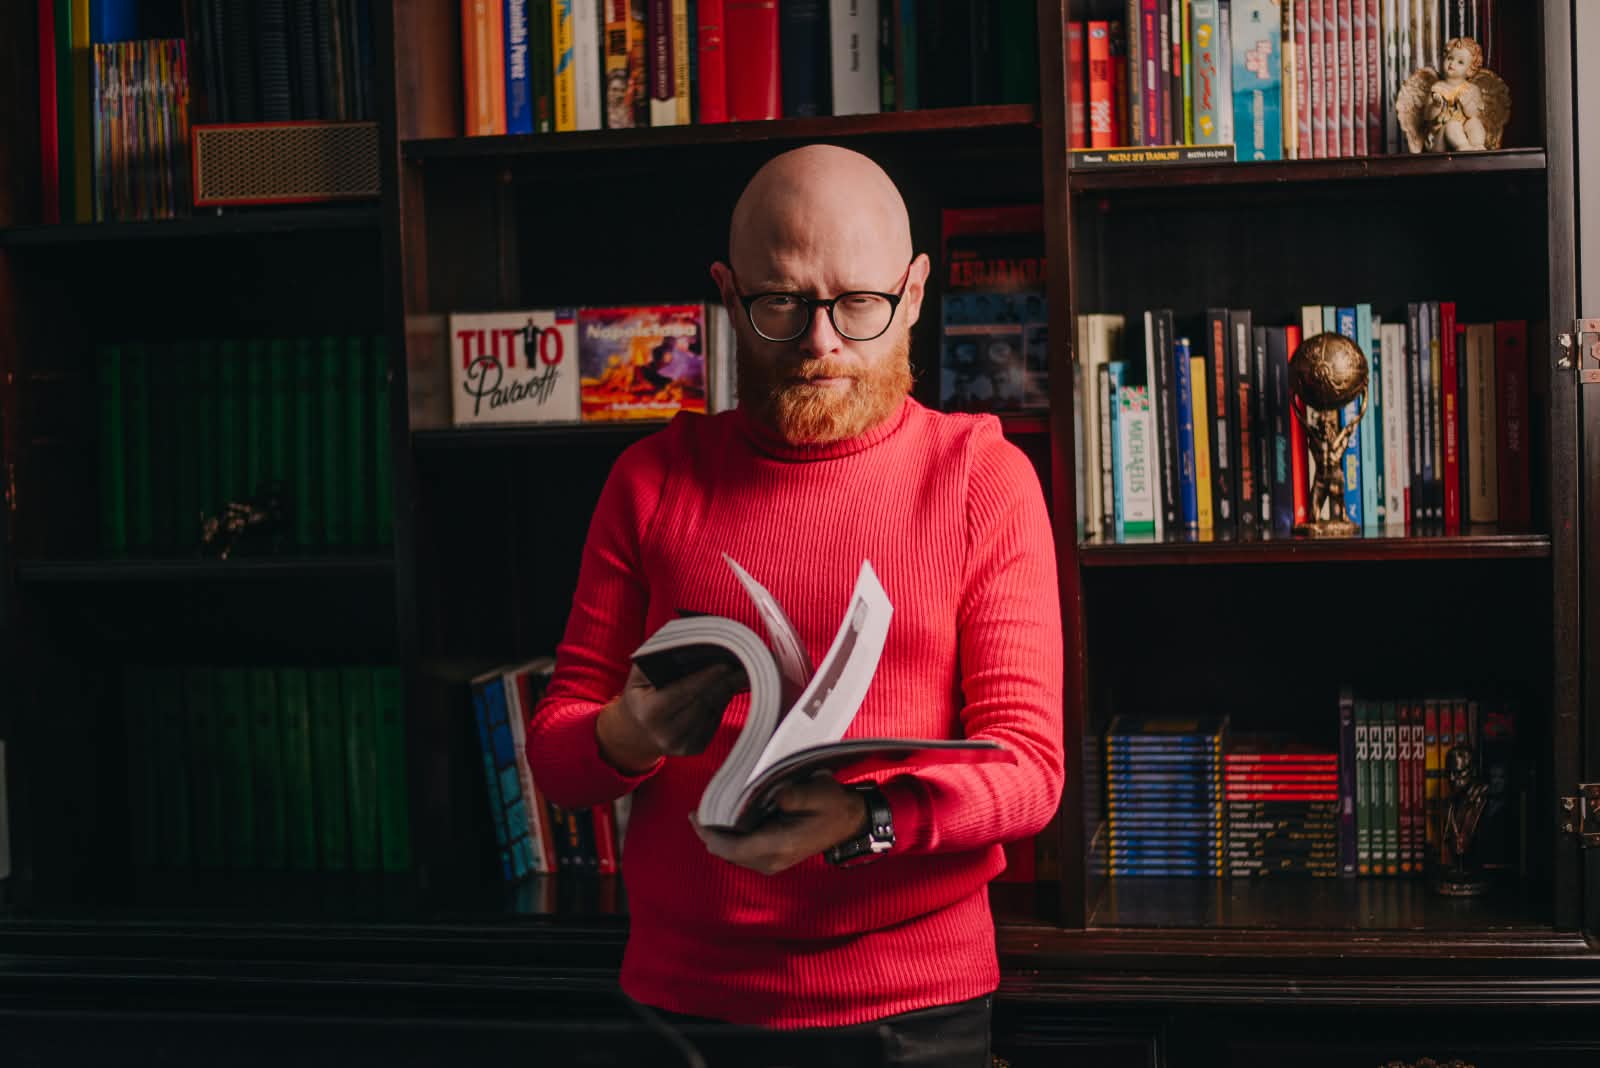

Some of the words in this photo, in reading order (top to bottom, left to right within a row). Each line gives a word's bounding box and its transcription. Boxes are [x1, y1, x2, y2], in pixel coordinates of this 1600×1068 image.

[1355, 725, 1368, 760] ER
[1369, 725, 1382, 760] ER
[1384, 725, 1397, 760] ER
[1398, 725, 1411, 760] ER
[1412, 725, 1425, 760] ER
